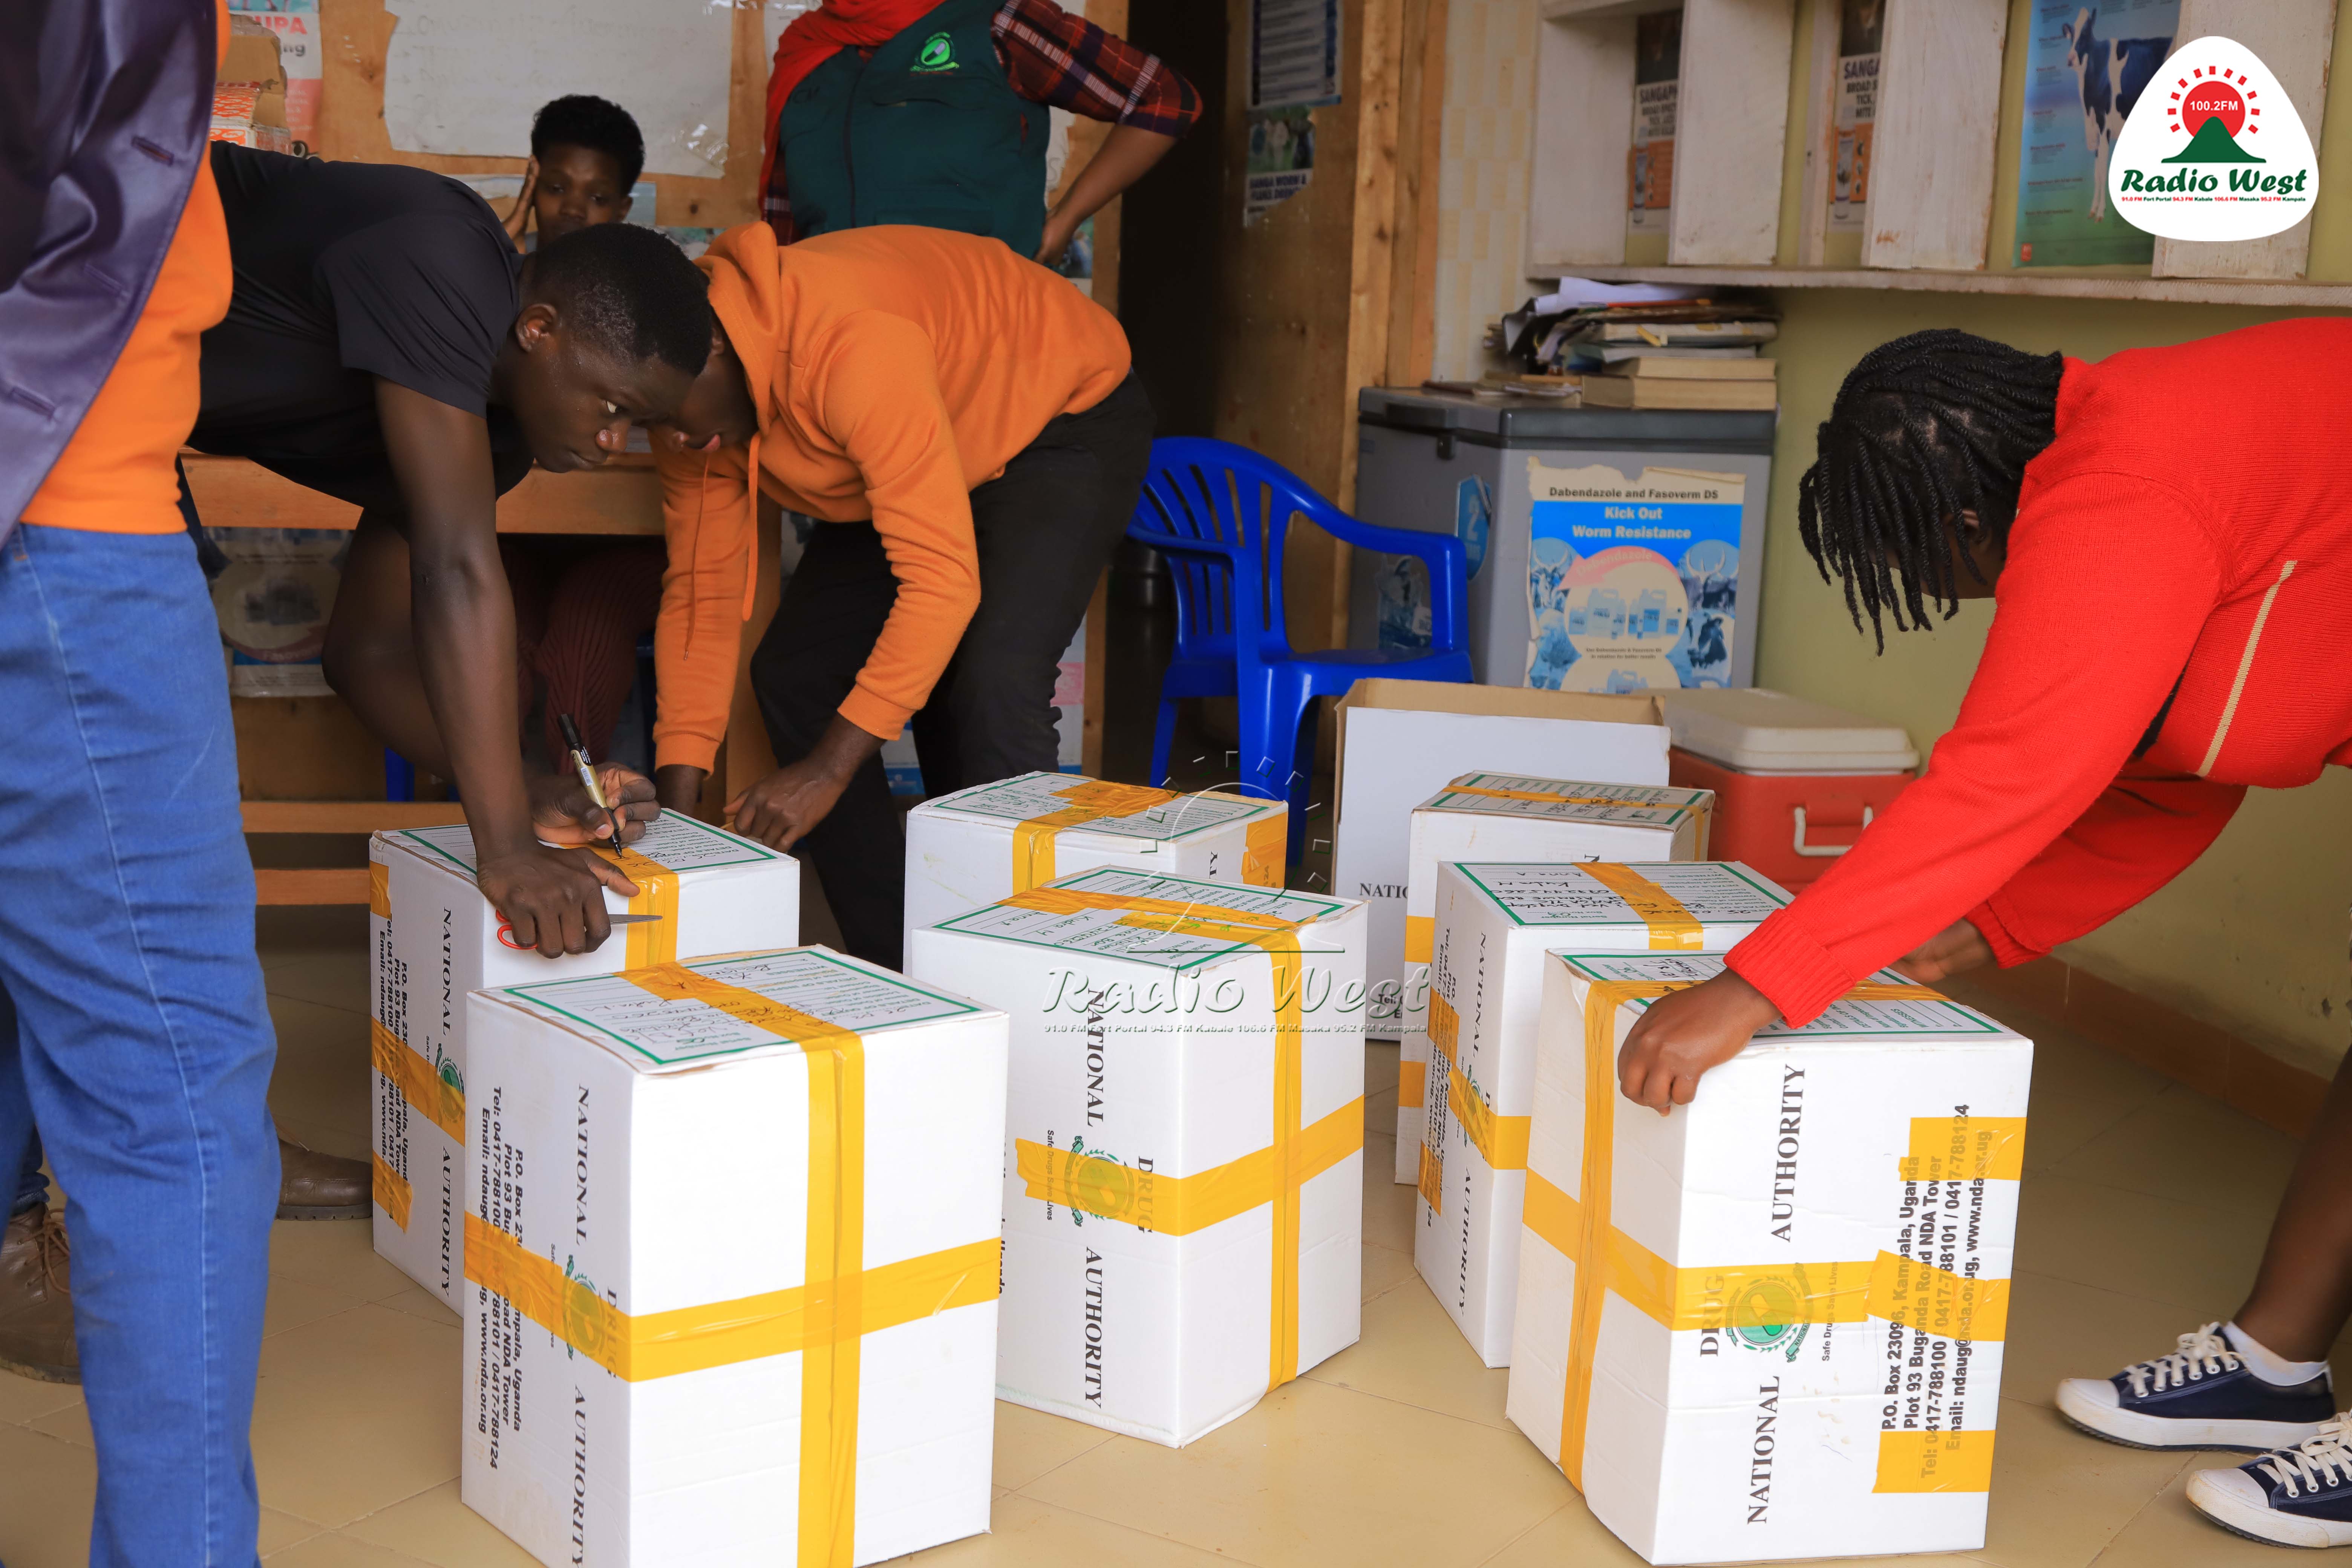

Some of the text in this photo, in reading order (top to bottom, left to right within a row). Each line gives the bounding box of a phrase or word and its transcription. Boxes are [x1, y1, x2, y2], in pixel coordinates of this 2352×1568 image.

[1550, 487, 1719, 499] Dabendazole and Fasoverm DS
[1605, 506, 1663, 520] Kick Out
[1572, 525, 1692, 539] Worm Resistance
[1109, 879, 1150, 892] WITNESSES
[395, 988, 400, 1008] 93
[442, 905, 451, 1040] NATIONAL
[764, 965, 829, 975] WITNESSES
[1473, 928, 1486, 1063] NATIONAL
[1824, 1018, 1852, 1028] Contact
[1842, 1015, 1876, 1027] DETAILS
[1844, 1004, 1878, 1017] Inspector:
[1877, 1014, 1912, 1027] Signature:
[1886, 1009, 1932, 1027] WITNESSES
[1086, 987, 1104, 1130] NATIONAL
[1433, 1048, 1442, 1135] 0417-788101
[1441, 1080, 1449, 1148] Kampala,
[492, 1119, 501, 1230] 0417-788100
[504, 1142, 512, 1179] Plot
[514, 1147, 523, 1183] P.O.
[576, 1082, 589, 1251] NATIONAL
[1045, 1149, 1054, 1176] Drugs
[1769, 1063, 1806, 1242] AUTHORITY
[440, 1143, 450, 1300] AUTHORITY
[504, 1180, 512, 1205] 93
[514, 1184, 523, 1220] Box
[1137, 1155, 1153, 1235] DRUG
[478, 1106, 490, 1436] Email: www.nda.or.ug
[1458, 1166, 1472, 1318] AUTHORITY
[1828, 1261, 1839, 1285] Lives
[1698, 1273, 1726, 1357] DRUG
[1881, 1156, 1923, 1430] P.O. Box 23096, Kampala, Uganda
[1903, 1156, 1942, 1429] Plot 93 Buganda Road NDA Tower
[1920, 1103, 1970, 1478] Tel: 0417-788100 0417-788101 0417-788124
[1945, 1401, 1965, 1450] Email:
[1963, 1131, 1993, 1252] www.nda.or.ug
[502, 1330, 511, 1371] NDA
[605, 1285, 617, 1380] DRUG
[1084, 1246, 1102, 1410] AUTHORITY
[1821, 1339, 1831, 1361] Safe
[1823, 1312, 1836, 1338] Drugs
[490, 1360, 499, 1472] 0417-788124
[501, 1370, 510, 1427] Tower
[511, 1365, 521, 1434] Uganda
[571, 1383, 586, 1568] AUTHORITY
[1746, 1375, 1781, 1524] NATIONAL
